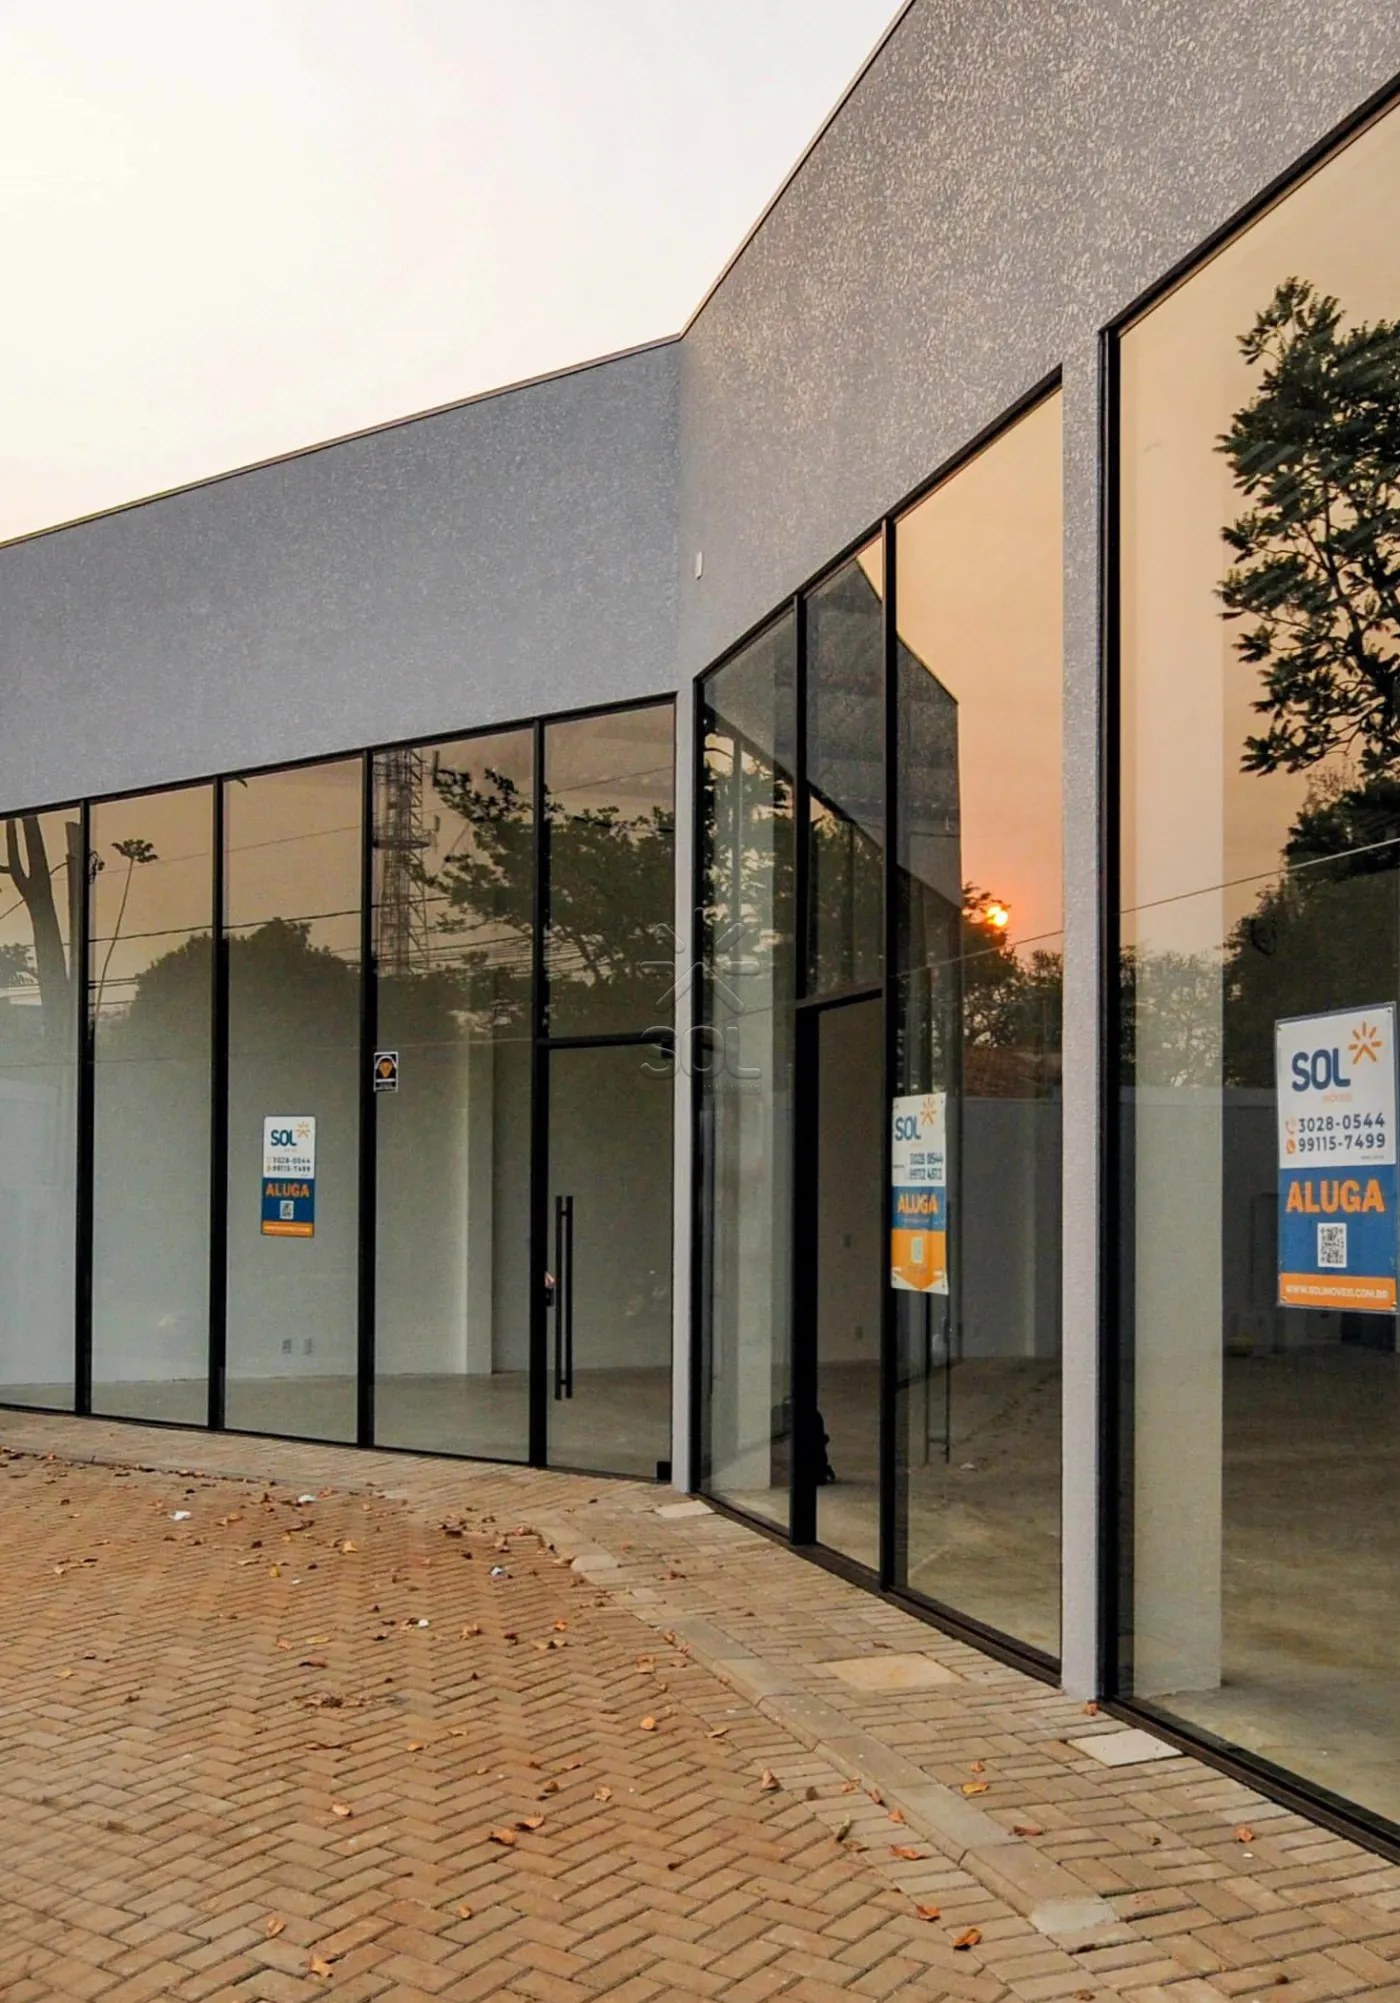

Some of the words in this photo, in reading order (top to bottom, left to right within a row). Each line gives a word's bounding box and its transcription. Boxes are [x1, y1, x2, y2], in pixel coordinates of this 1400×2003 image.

[1291, 1047, 1351, 1092] SOL
[895, 1115, 921, 1141] SOL
[1298, 1112, 1385, 1133] 3028-0544
[270, 1129, 298, 1146] SOL
[1298, 1132, 1386, 1152] 99115-7499
[266, 1183, 309, 1198] ALUGA
[1286, 1179, 1385, 1214] ALUGA
[897, 1192, 939, 1215] ALUGA
